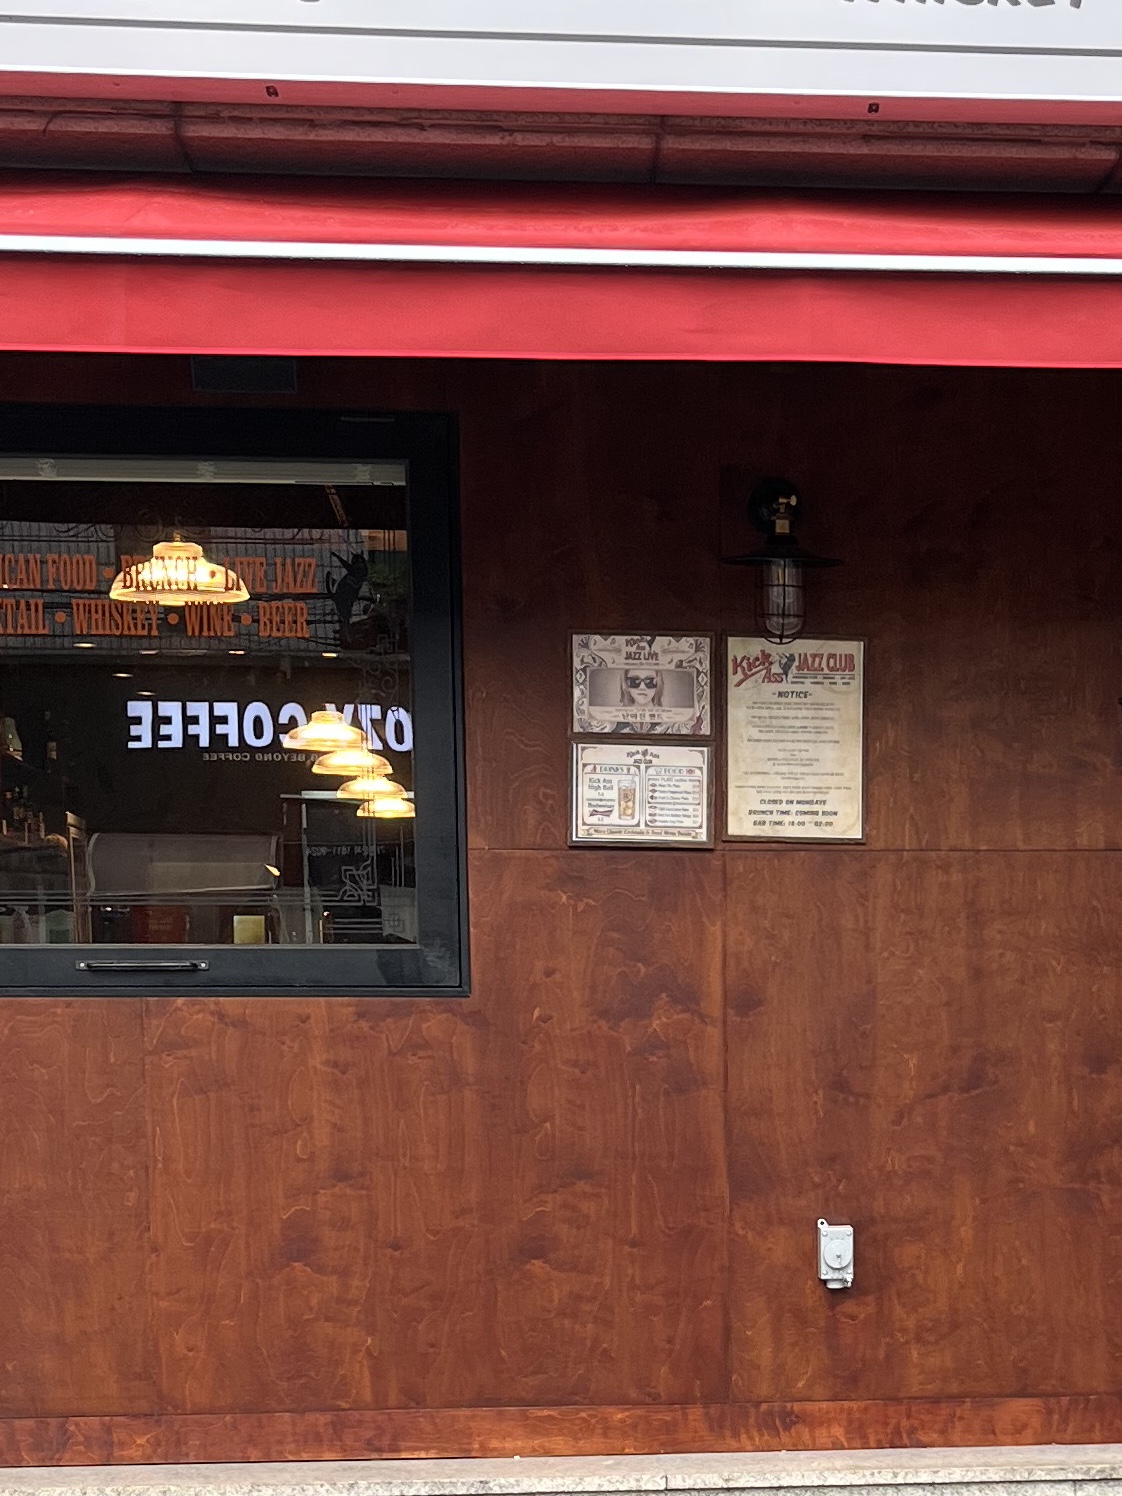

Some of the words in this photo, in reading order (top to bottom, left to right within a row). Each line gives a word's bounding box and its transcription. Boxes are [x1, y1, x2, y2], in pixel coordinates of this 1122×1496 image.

[47, 553, 98, 591] FOOD
[224, 556, 267, 592] LIVE
[273, 557, 319, 593] JAZZ
[71, 598, 160, 636] WHISKEY
[184, 601, 235, 637] WINE
[258, 602, 310, 638] BEER
[731, 649, 774, 685] Kick
[762, 668, 784, 683] Ass
[795, 653, 825, 672] JAZZ
[826, 653, 855, 672] CLUB
